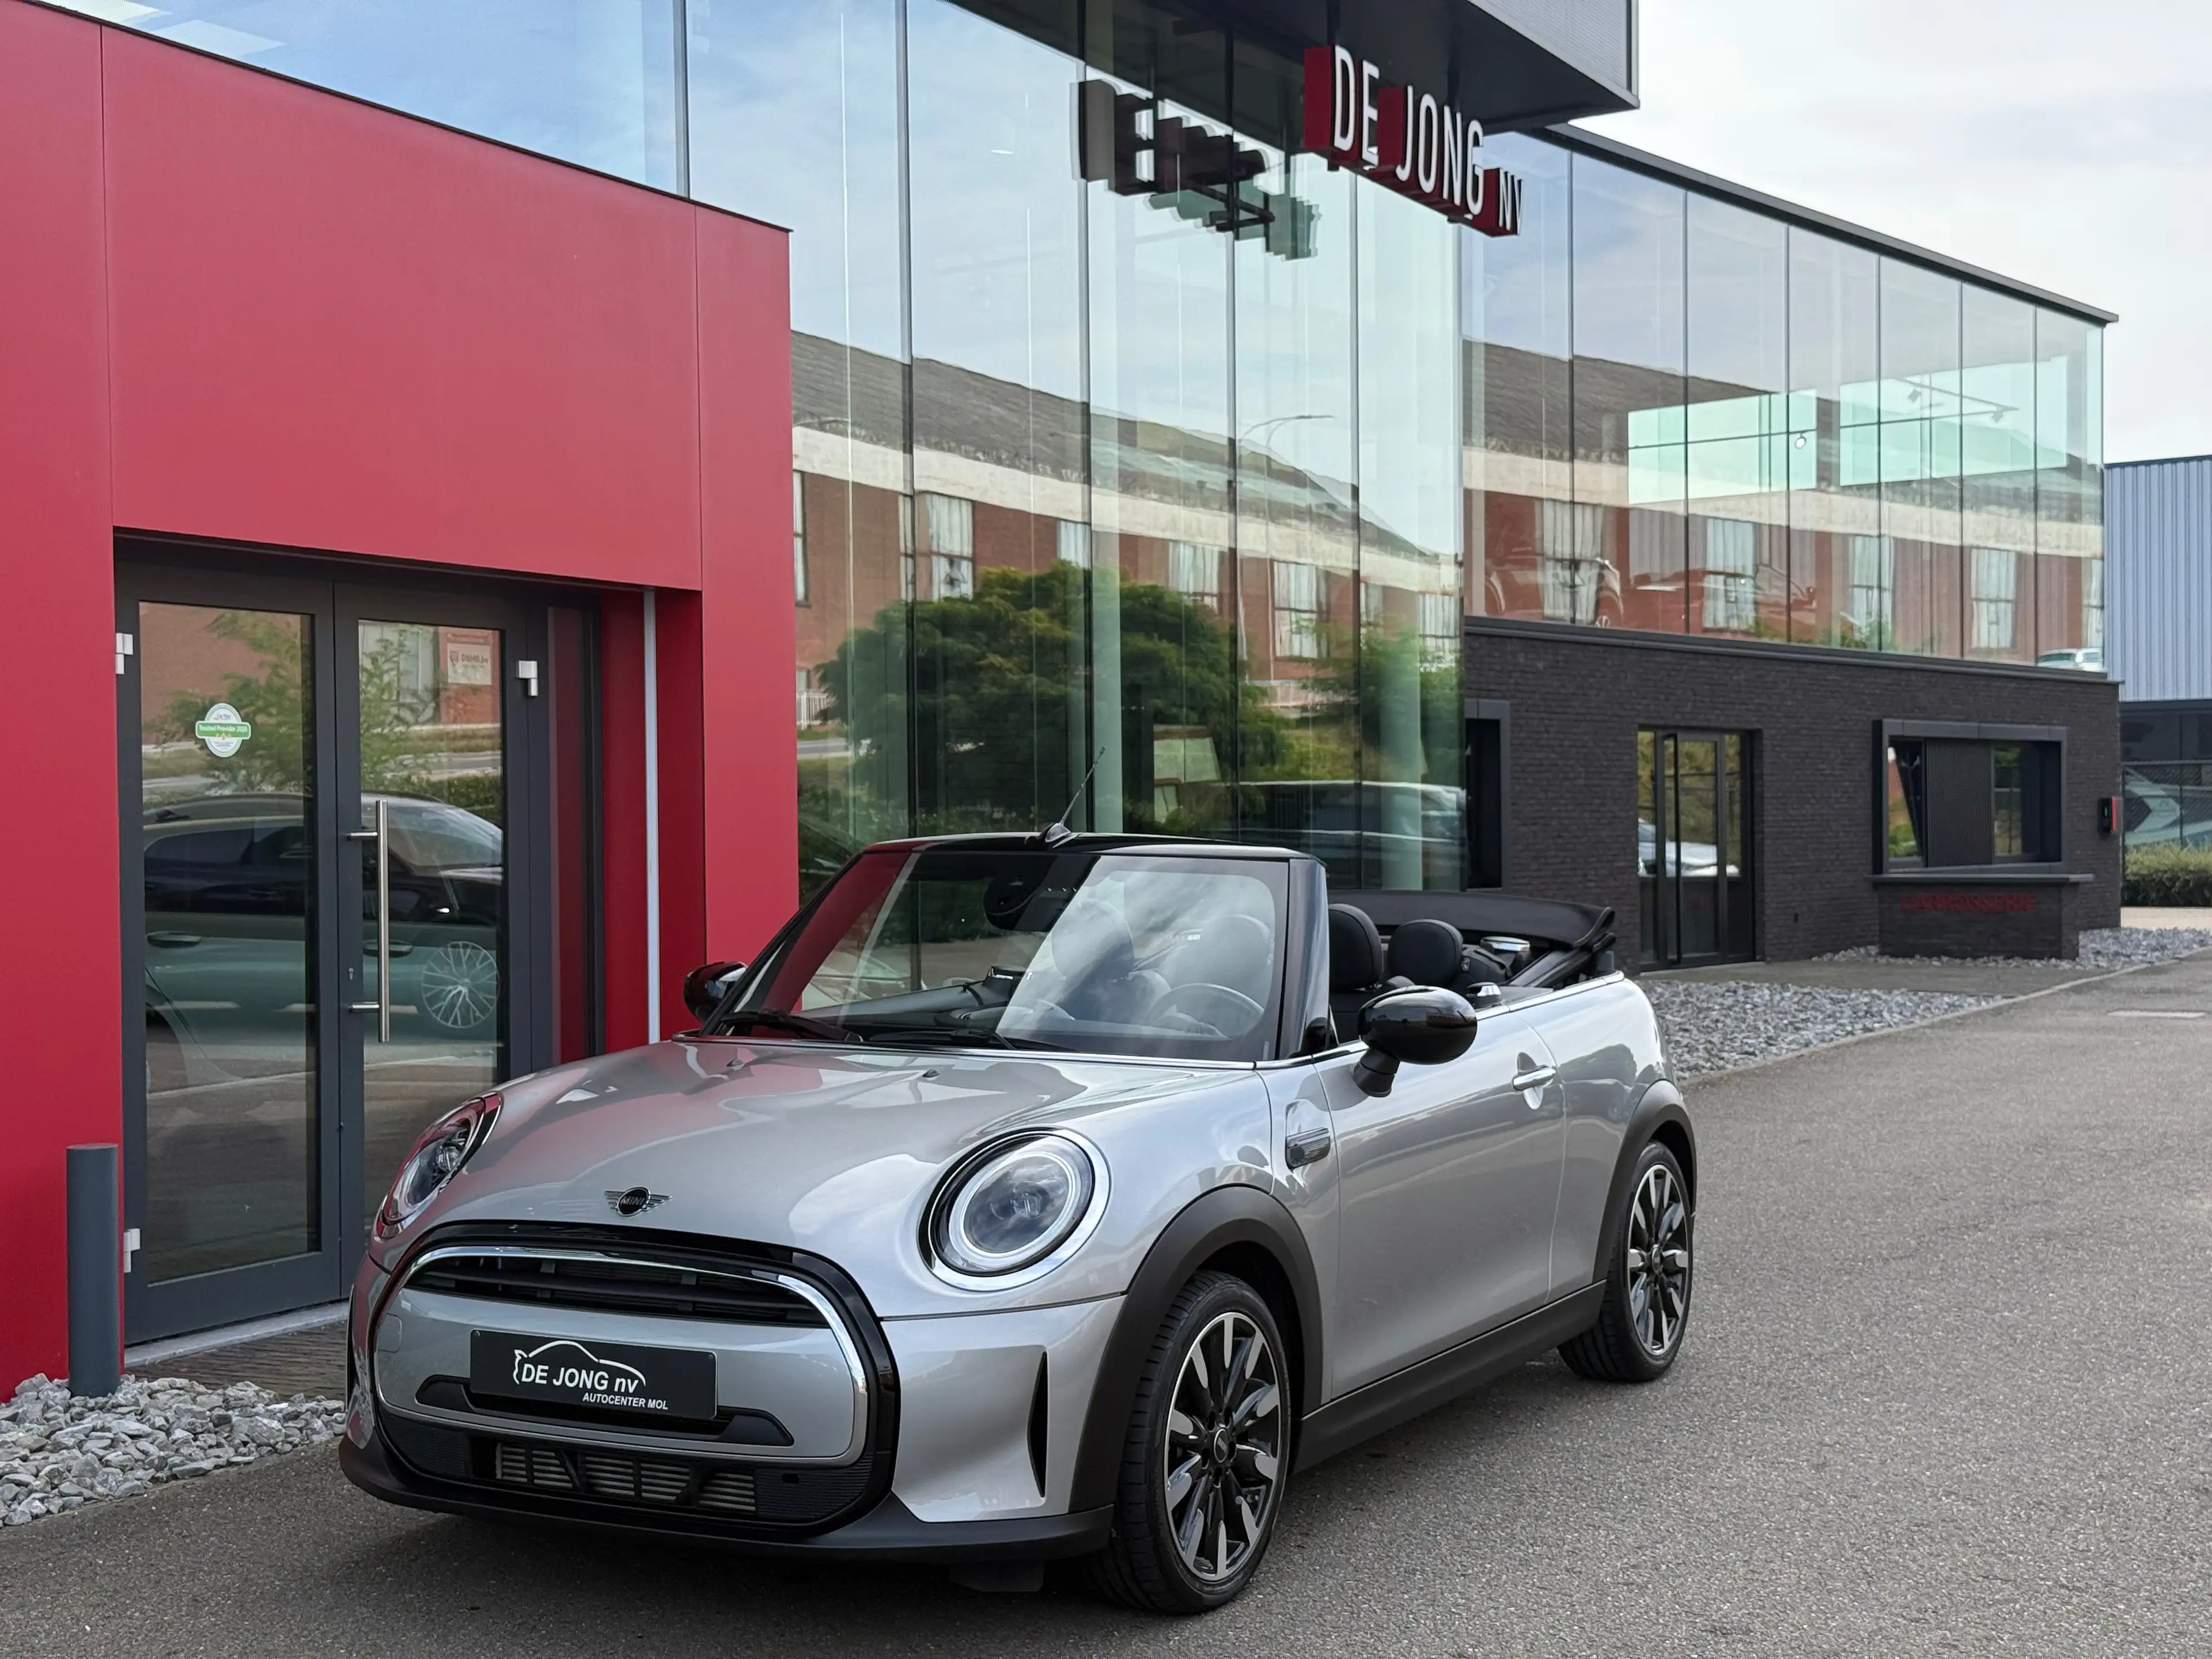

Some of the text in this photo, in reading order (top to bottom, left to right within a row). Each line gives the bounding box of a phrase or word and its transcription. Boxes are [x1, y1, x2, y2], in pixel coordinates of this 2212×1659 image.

[1334, 45, 1524, 236] DE JONG NV
[620, 1196, 646, 1206] MINI
[521, 1363, 639, 1394] DE JONG nv
[582, 1392, 669, 1410] AUTOCENTER MOL
